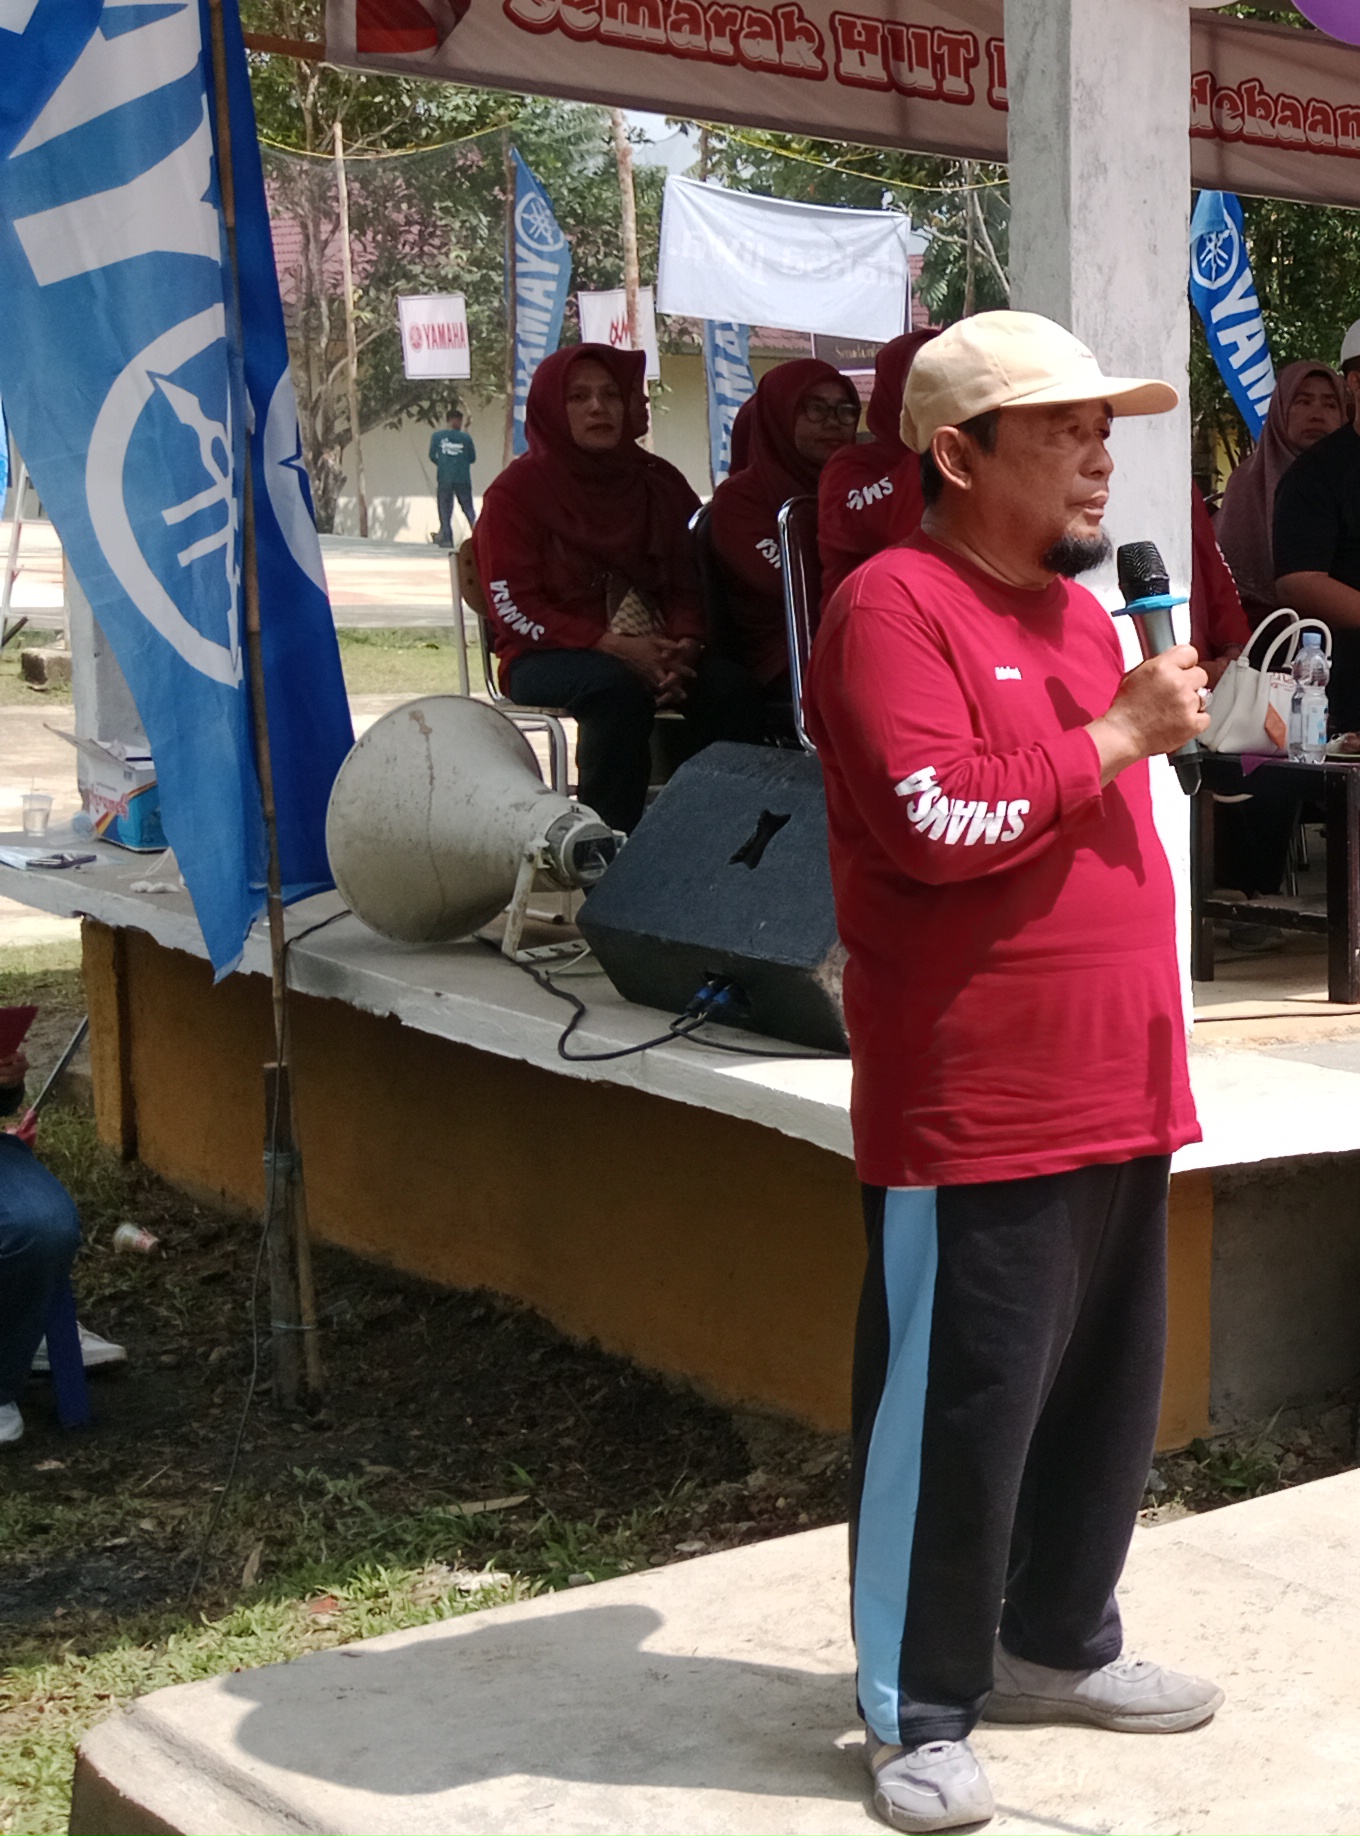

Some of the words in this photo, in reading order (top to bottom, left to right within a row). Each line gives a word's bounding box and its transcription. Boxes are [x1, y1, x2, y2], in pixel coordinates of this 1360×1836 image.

[830, 10, 980, 106] HUT
[422, 322, 467, 350] YAMAHA
[489, 579, 545, 641] SMANSA
[893, 765, 1031, 846] SMANSA
